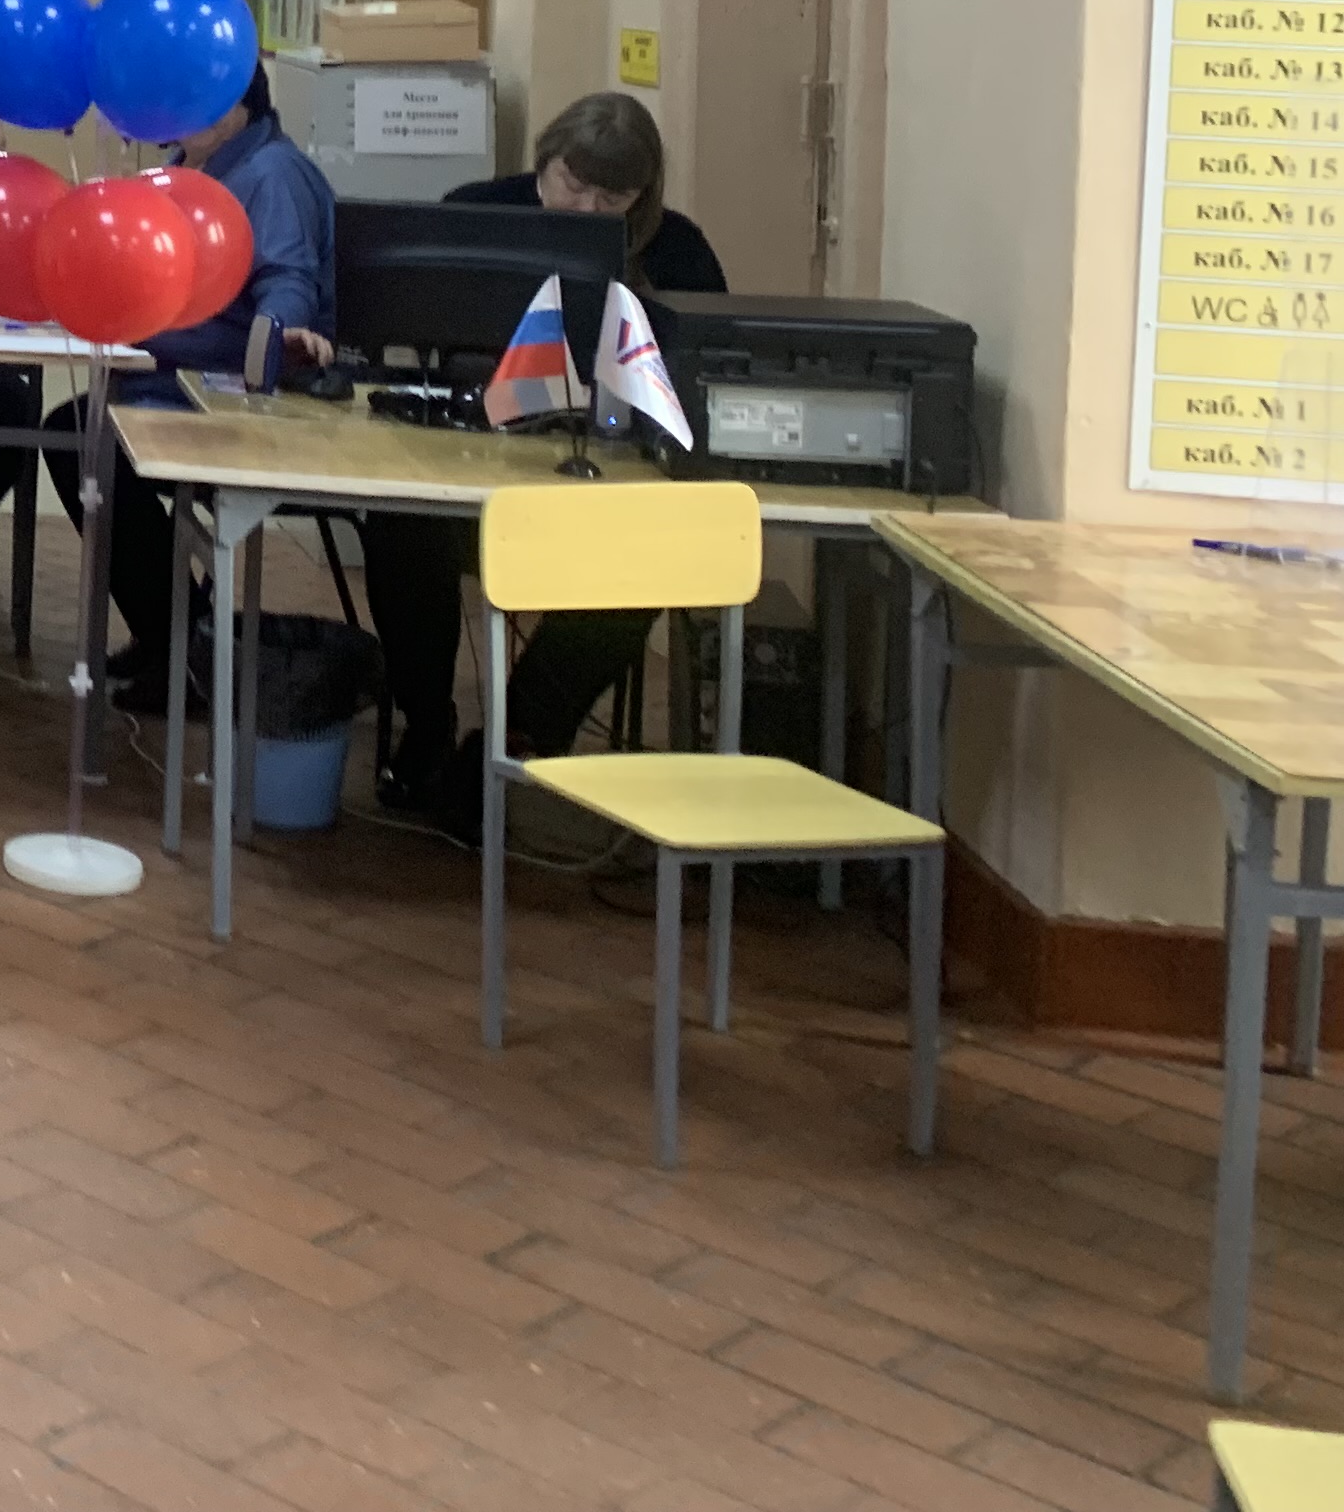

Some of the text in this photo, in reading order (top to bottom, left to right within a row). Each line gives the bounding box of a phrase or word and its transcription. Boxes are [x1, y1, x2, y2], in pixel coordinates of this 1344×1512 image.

[1206, 8, 1263, 30] каб.
[1318, 12, 1344, 34] 12
[1204, 57, 1260, 79] каб.
[1315, 61, 1343, 83] 13
[1201, 106, 1258, 128] каб.
[1312, 109, 1339, 131] 14
[1199, 153, 1256, 175] каб.
[1310, 157, 1338, 179] 15
[1196, 200, 1254, 222] каб.
[1307, 205, 1335, 226] 16
[1194, 248, 1252, 270] каб.
[1304, 251, 1333, 274] 17
[1191, 295, 1248, 323] WC
[1186, 395, 1243, 417] каб.
[1184, 444, 1241, 466] каб.
[1293, 448, 1306, 470] 2
